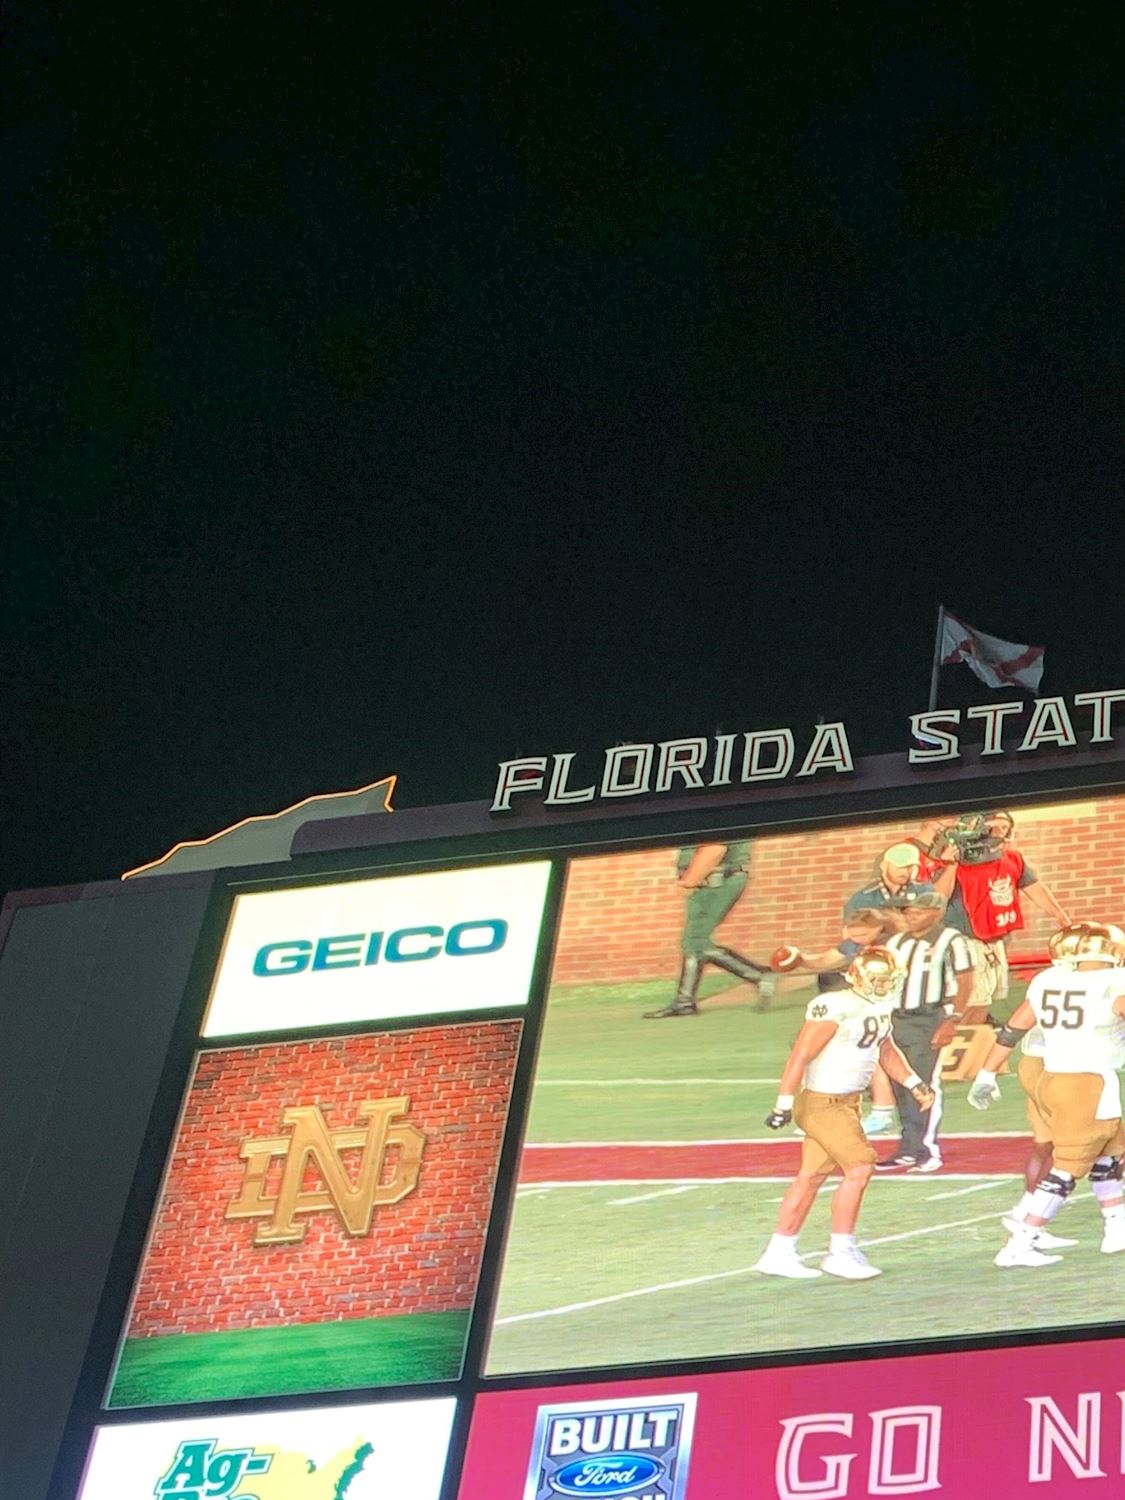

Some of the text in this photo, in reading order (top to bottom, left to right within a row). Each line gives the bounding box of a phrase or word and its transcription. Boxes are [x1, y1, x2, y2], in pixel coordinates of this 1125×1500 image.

[489, 722, 855, 812] FLORIDA
[252, 918, 508, 978] GEICO
[1040, 989, 1087, 1030] 55
[550, 1407, 678, 1456] BUILT
[156, 1437, 274, 1494] Ag-
[574, 1462, 637, 1487] Ford
